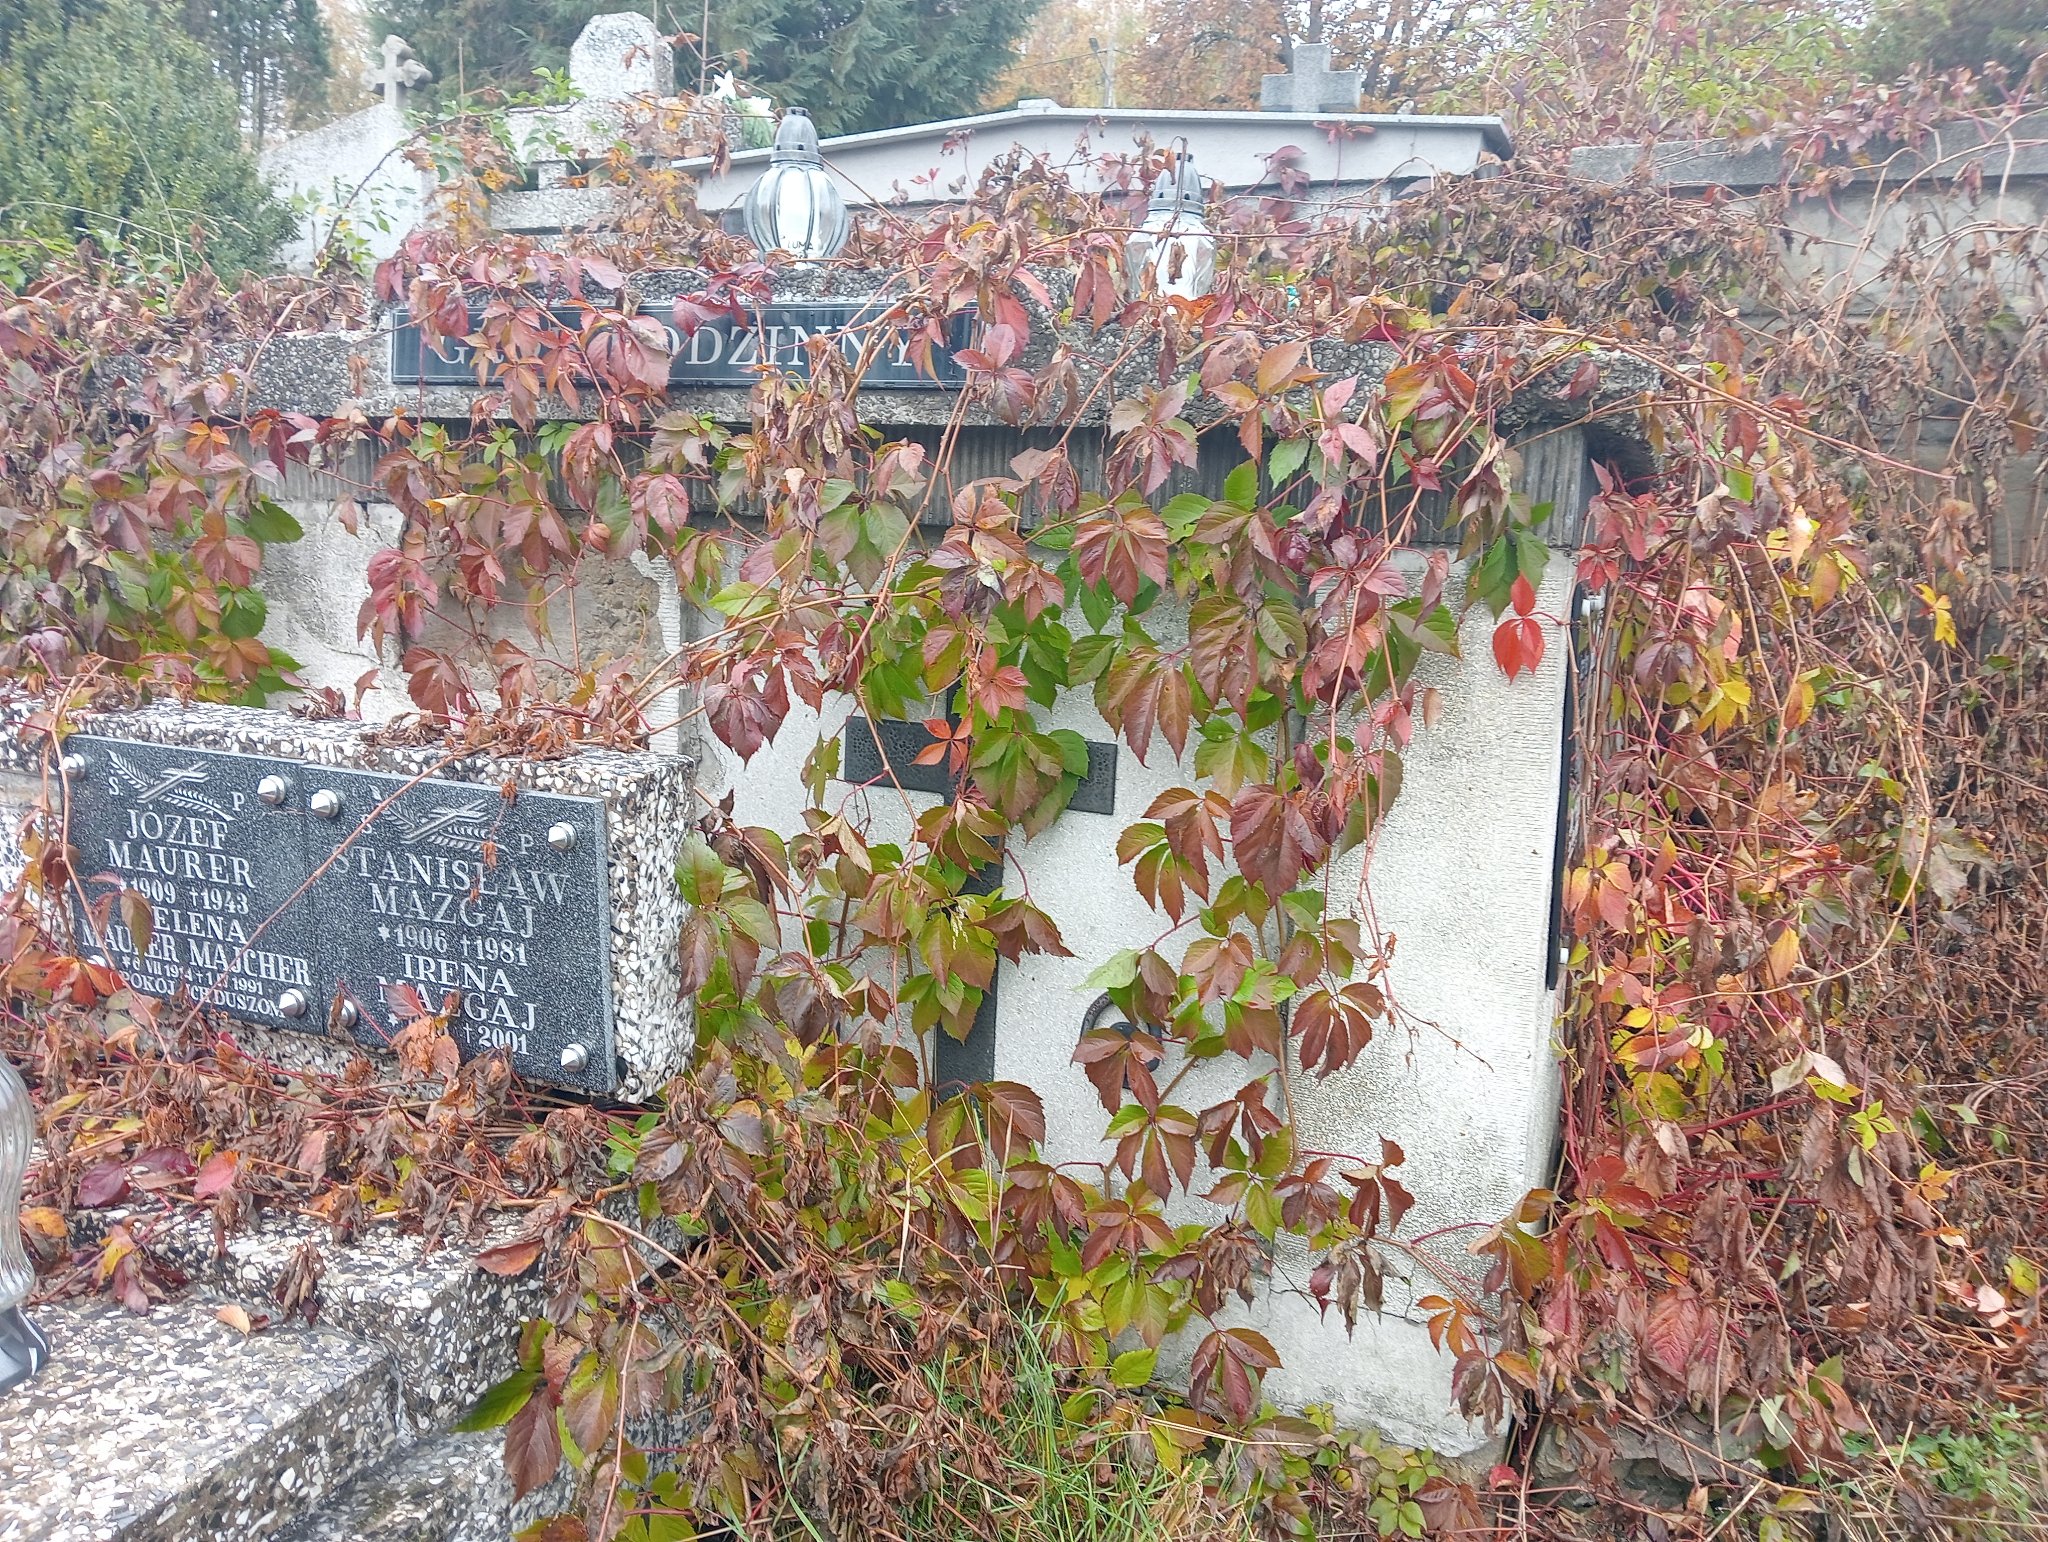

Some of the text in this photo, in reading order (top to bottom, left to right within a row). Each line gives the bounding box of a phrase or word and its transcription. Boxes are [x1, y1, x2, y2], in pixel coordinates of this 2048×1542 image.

[105, 838, 256, 889] MAURER
[133, 902, 248, 945] ELENA
[370, 882, 536, 939] MAZGAJ
[80, 918, 312, 987] MAUER MAJCHER
[401, 953, 519, 998] IRENA
[232, 977, 264, 995] 1991
